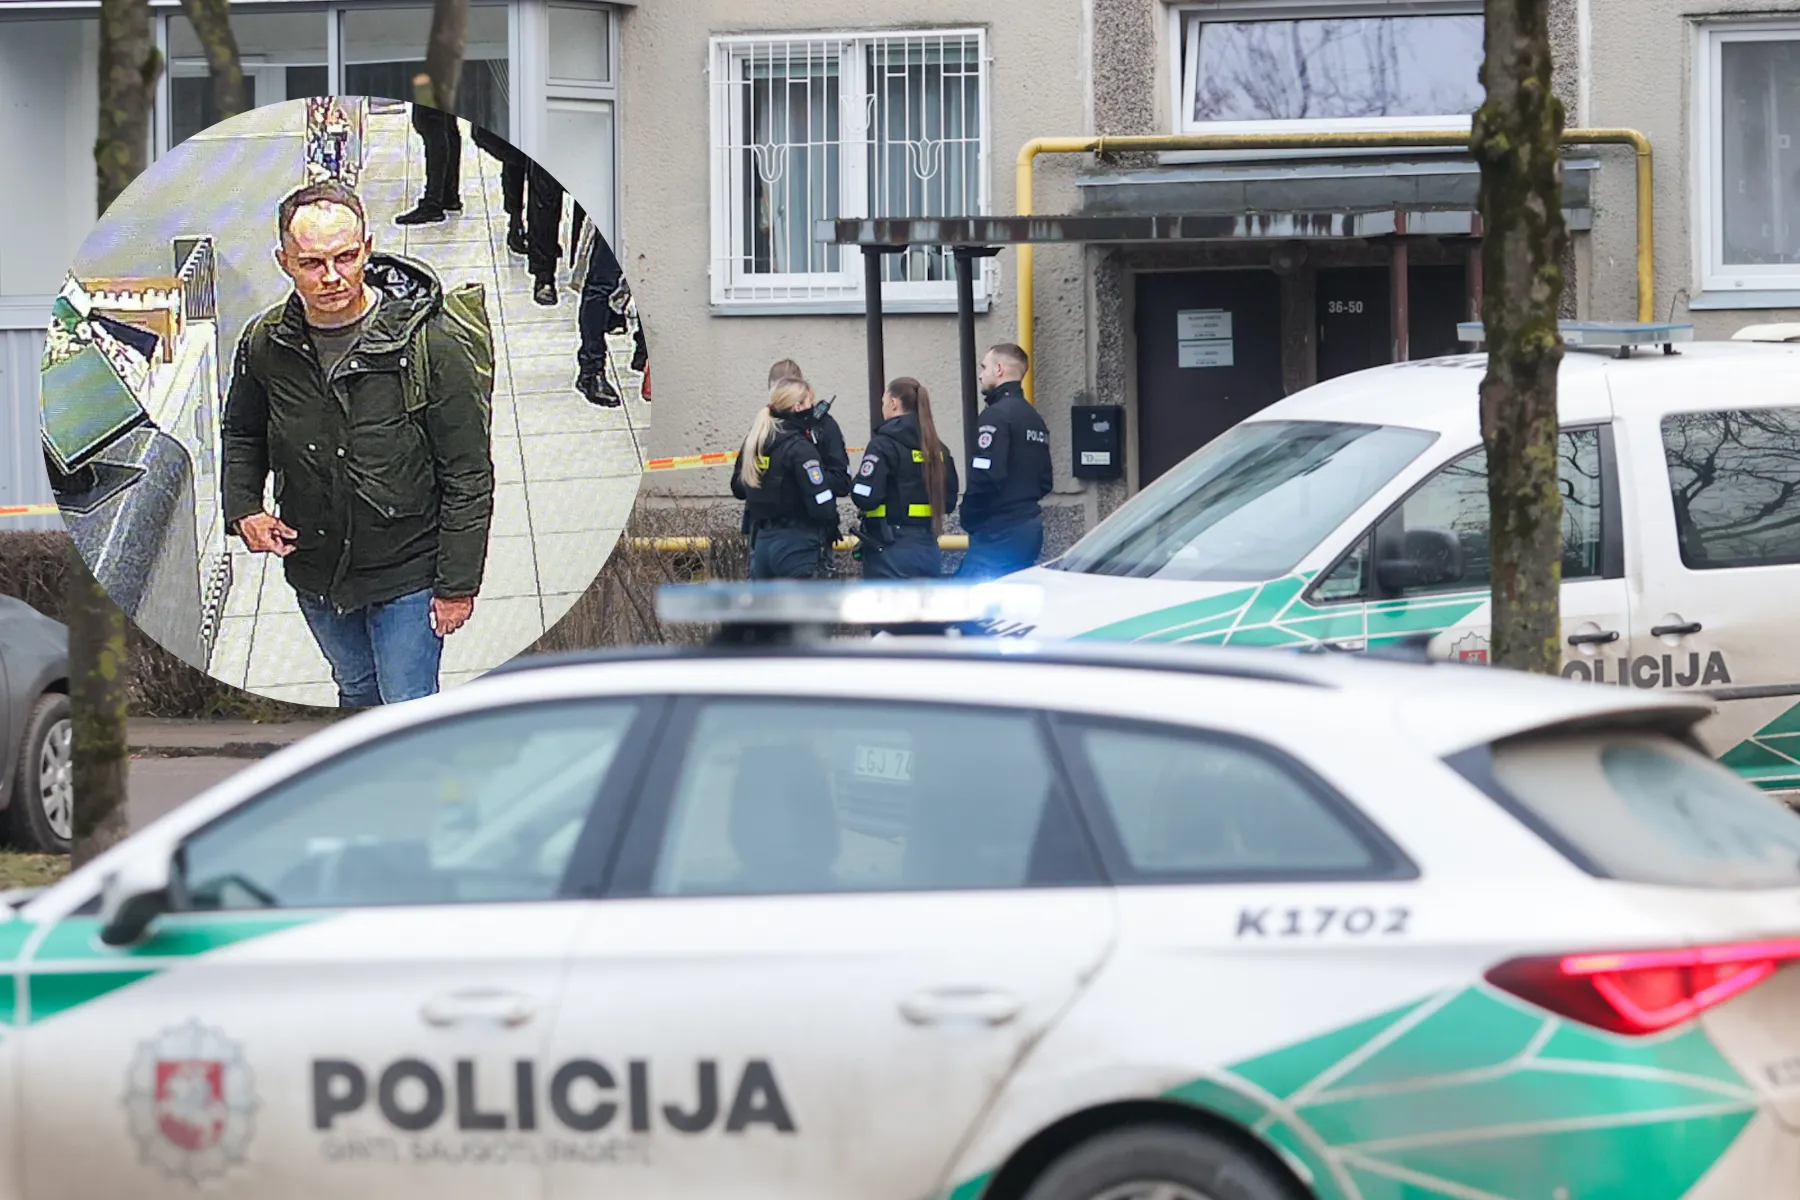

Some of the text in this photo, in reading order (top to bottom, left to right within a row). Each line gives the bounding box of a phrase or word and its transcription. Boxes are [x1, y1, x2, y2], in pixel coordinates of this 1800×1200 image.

[1328, 300, 1364, 314] 36-50
[1562, 651, 1732, 690] OLICIJA
[1236, 906, 1413, 937] K1702
[311, 1058, 797, 1133] POLICIJA
